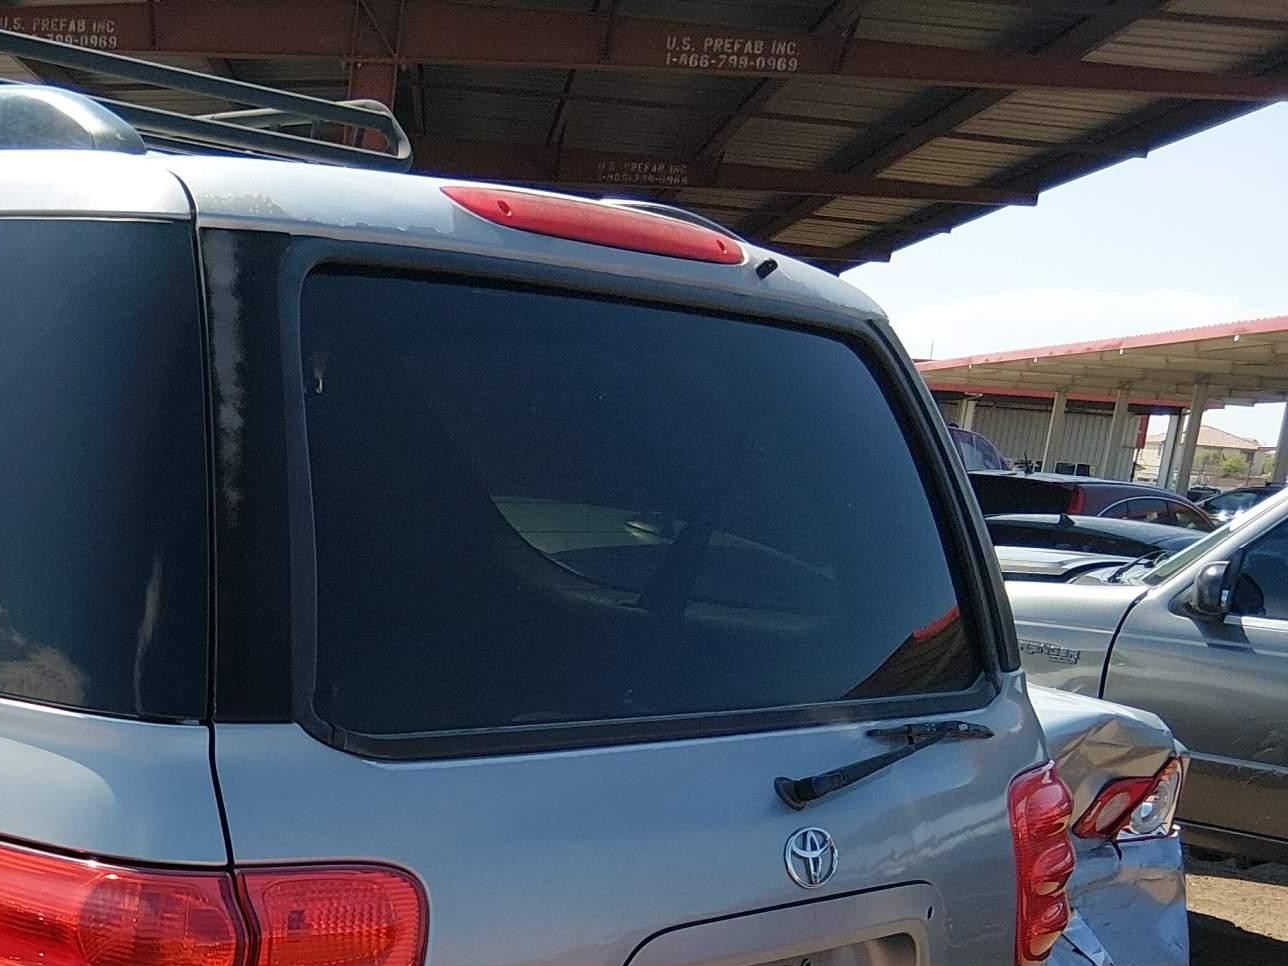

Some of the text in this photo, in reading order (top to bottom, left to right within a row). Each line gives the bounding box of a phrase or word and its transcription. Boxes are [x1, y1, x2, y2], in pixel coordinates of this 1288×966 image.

[32, 18, 87, 32] PREFAB
[666, 36, 801, 56] U.S. PREFAB INC.
[665, 52, 799, 72] 1-866-799-0969
